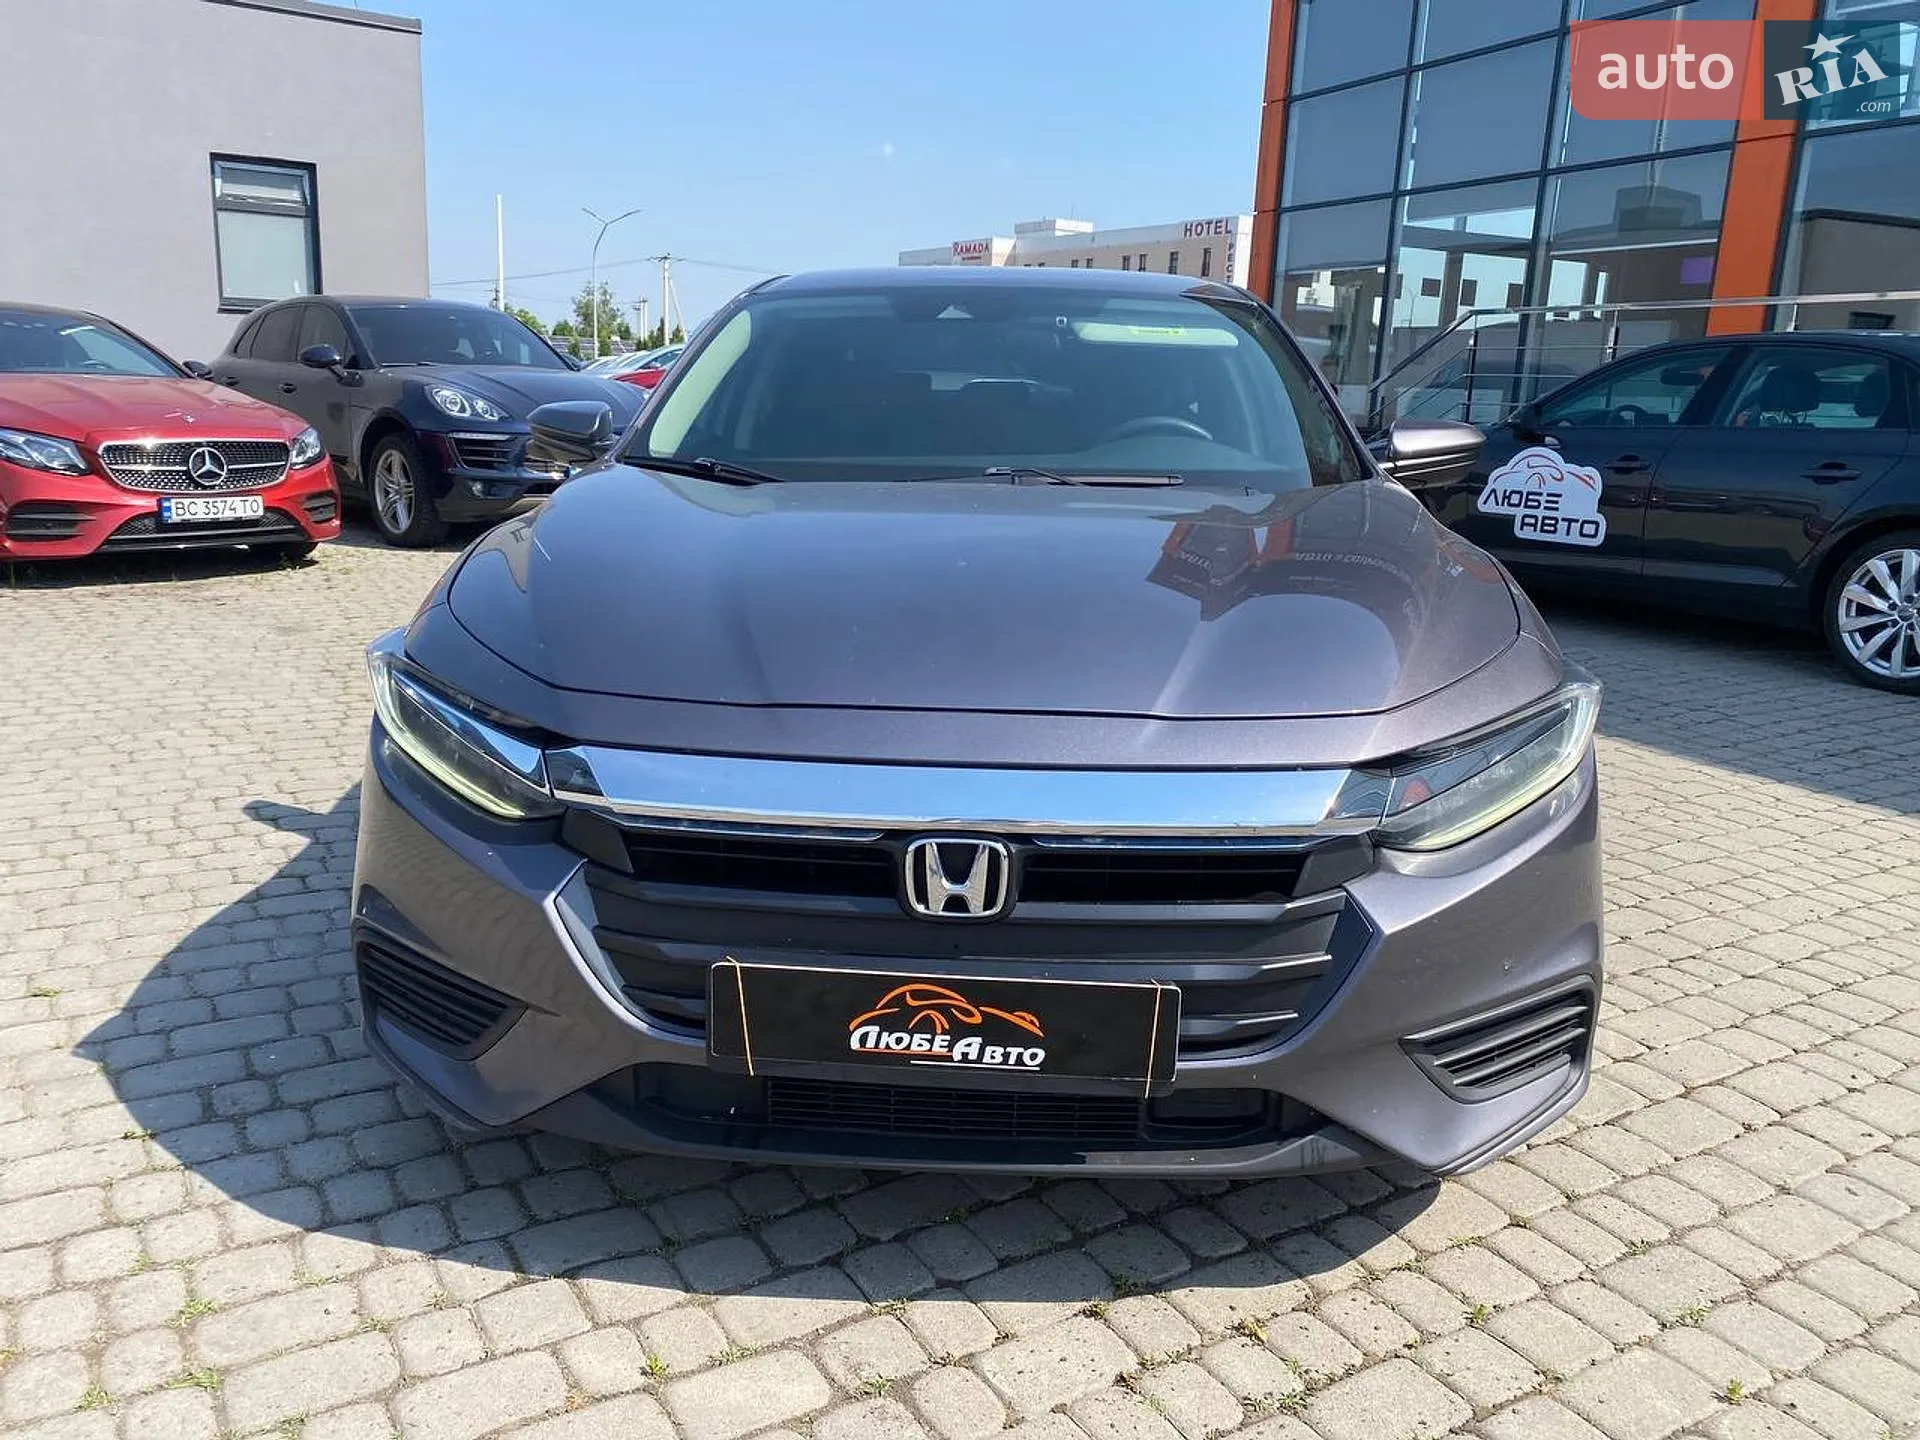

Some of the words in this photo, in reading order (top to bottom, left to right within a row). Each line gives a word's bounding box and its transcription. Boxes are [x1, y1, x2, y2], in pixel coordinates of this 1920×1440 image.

[1183, 218, 1232, 238] HOTEL
[175, 501, 198, 517] BC
[203, 500, 237, 516] 3574
[1482, 488, 1563, 511] ЛЮБЕ
[1519, 513, 1600, 539] АВТО
